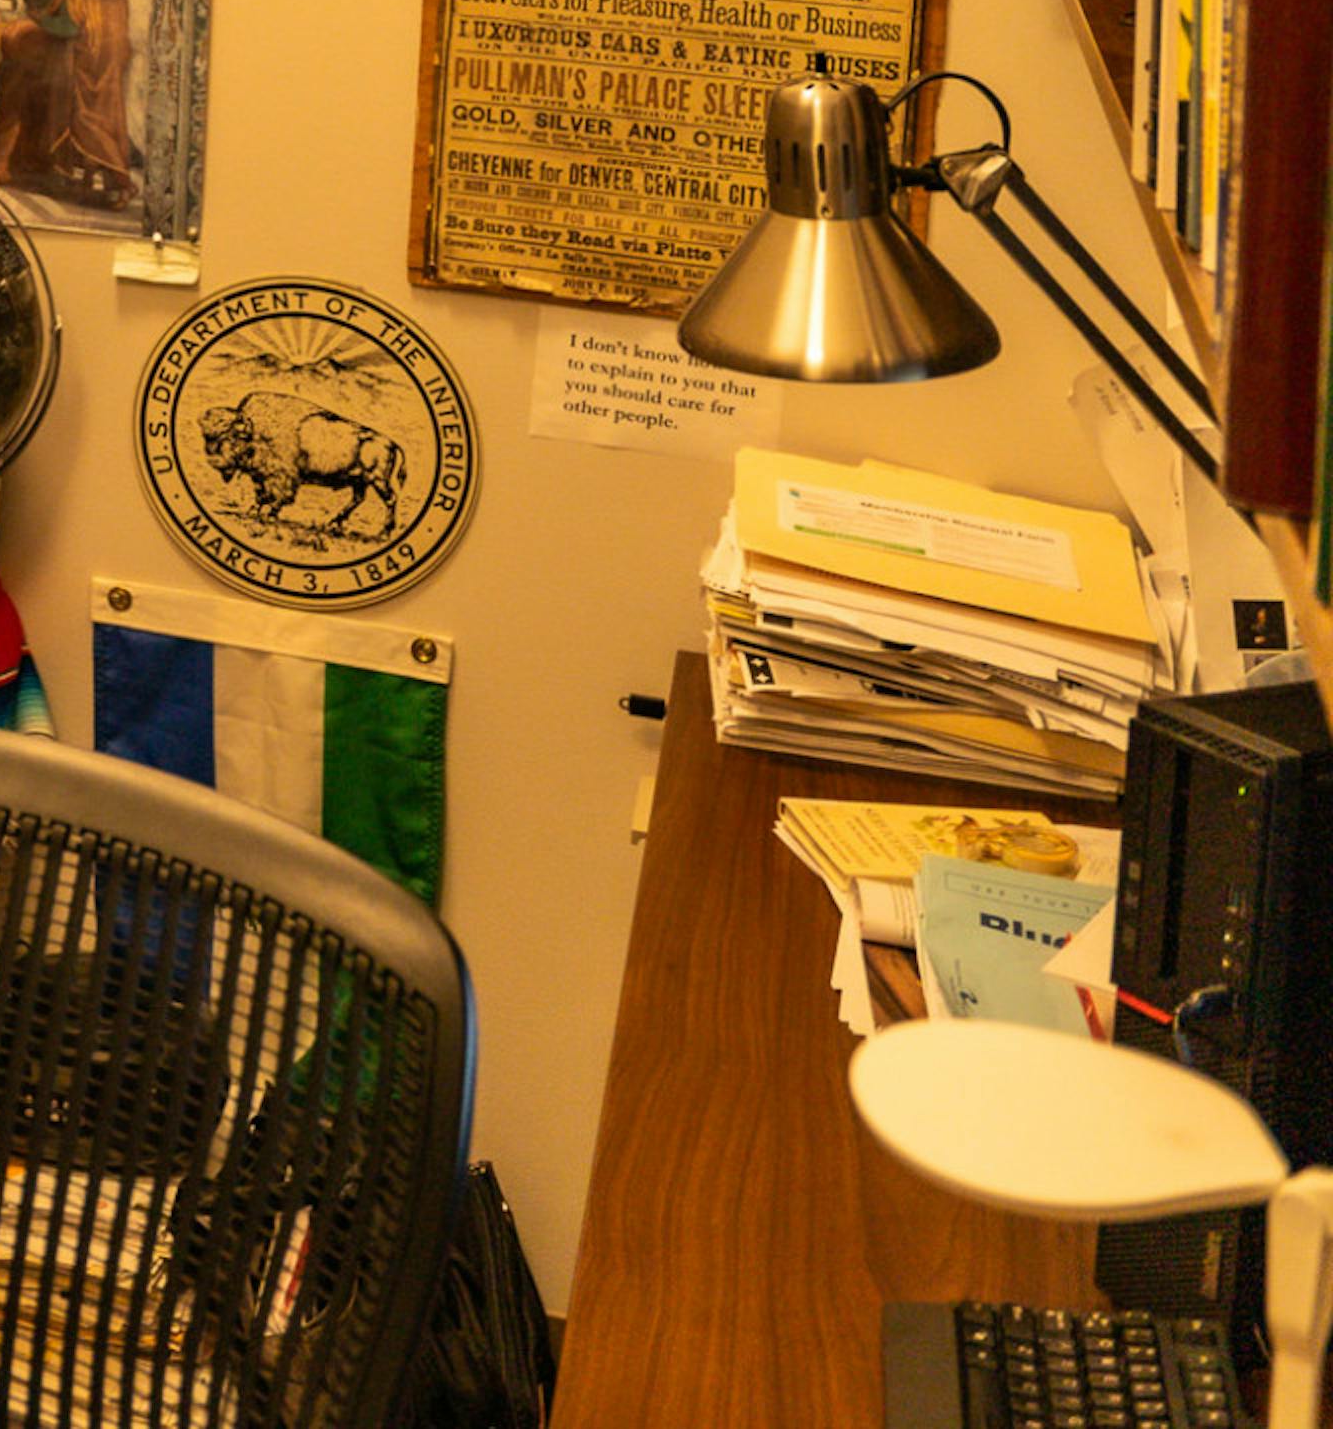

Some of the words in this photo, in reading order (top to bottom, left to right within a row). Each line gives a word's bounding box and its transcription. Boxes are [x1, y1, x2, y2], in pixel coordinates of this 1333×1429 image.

[777, 10, 802, 31] or
[805, 6, 902, 44] Business
[601, 32, 660, 56] CARS
[672, 41, 687, 60] &
[704, 42, 792, 69] EATING
[453, 56, 587, 101] PULLMAN'S
[599, 71, 692, 112] PALACE
[452, 104, 521, 128] GOLD,
[535, 111, 613, 136] SILVER
[628, 122, 676, 143] AND
[447, 150, 534, 180] CHEYENNE
[539, 161, 564, 183] for
[644, 171, 722, 203] CENTRAL
[728, 184, 768, 209] CITY
[444, 214, 469, 230] Be
[473, 218, 516, 236] Sure
[520, 224, 562, 246] they
[622, 239, 649, 254] via
[654, 240, 712, 262] Platte
[569, 334, 577, 348] I
[583, 335, 628, 356] don't
[634, 344, 683, 365] know
[565, 378, 597, 395] you
[602, 382, 662, 404] should
[667, 397, 705, 412] care
[710, 398, 736, 417] for
[568, 358, 584, 371] to
[590, 361, 654, 383] explain
[660, 373, 677, 385] to
[683, 377, 715, 392] you
[721, 381, 757, 399] that
[325, 296, 366, 325] OF
[380, 319, 426, 368] THE
[424, 374, 465, 513] INTERIOR
[563, 399, 615, 418] other
[613, 408, 678, 430] people.
[184, 513, 284, 587] MARCH
[350, 542, 417, 588] 1849
